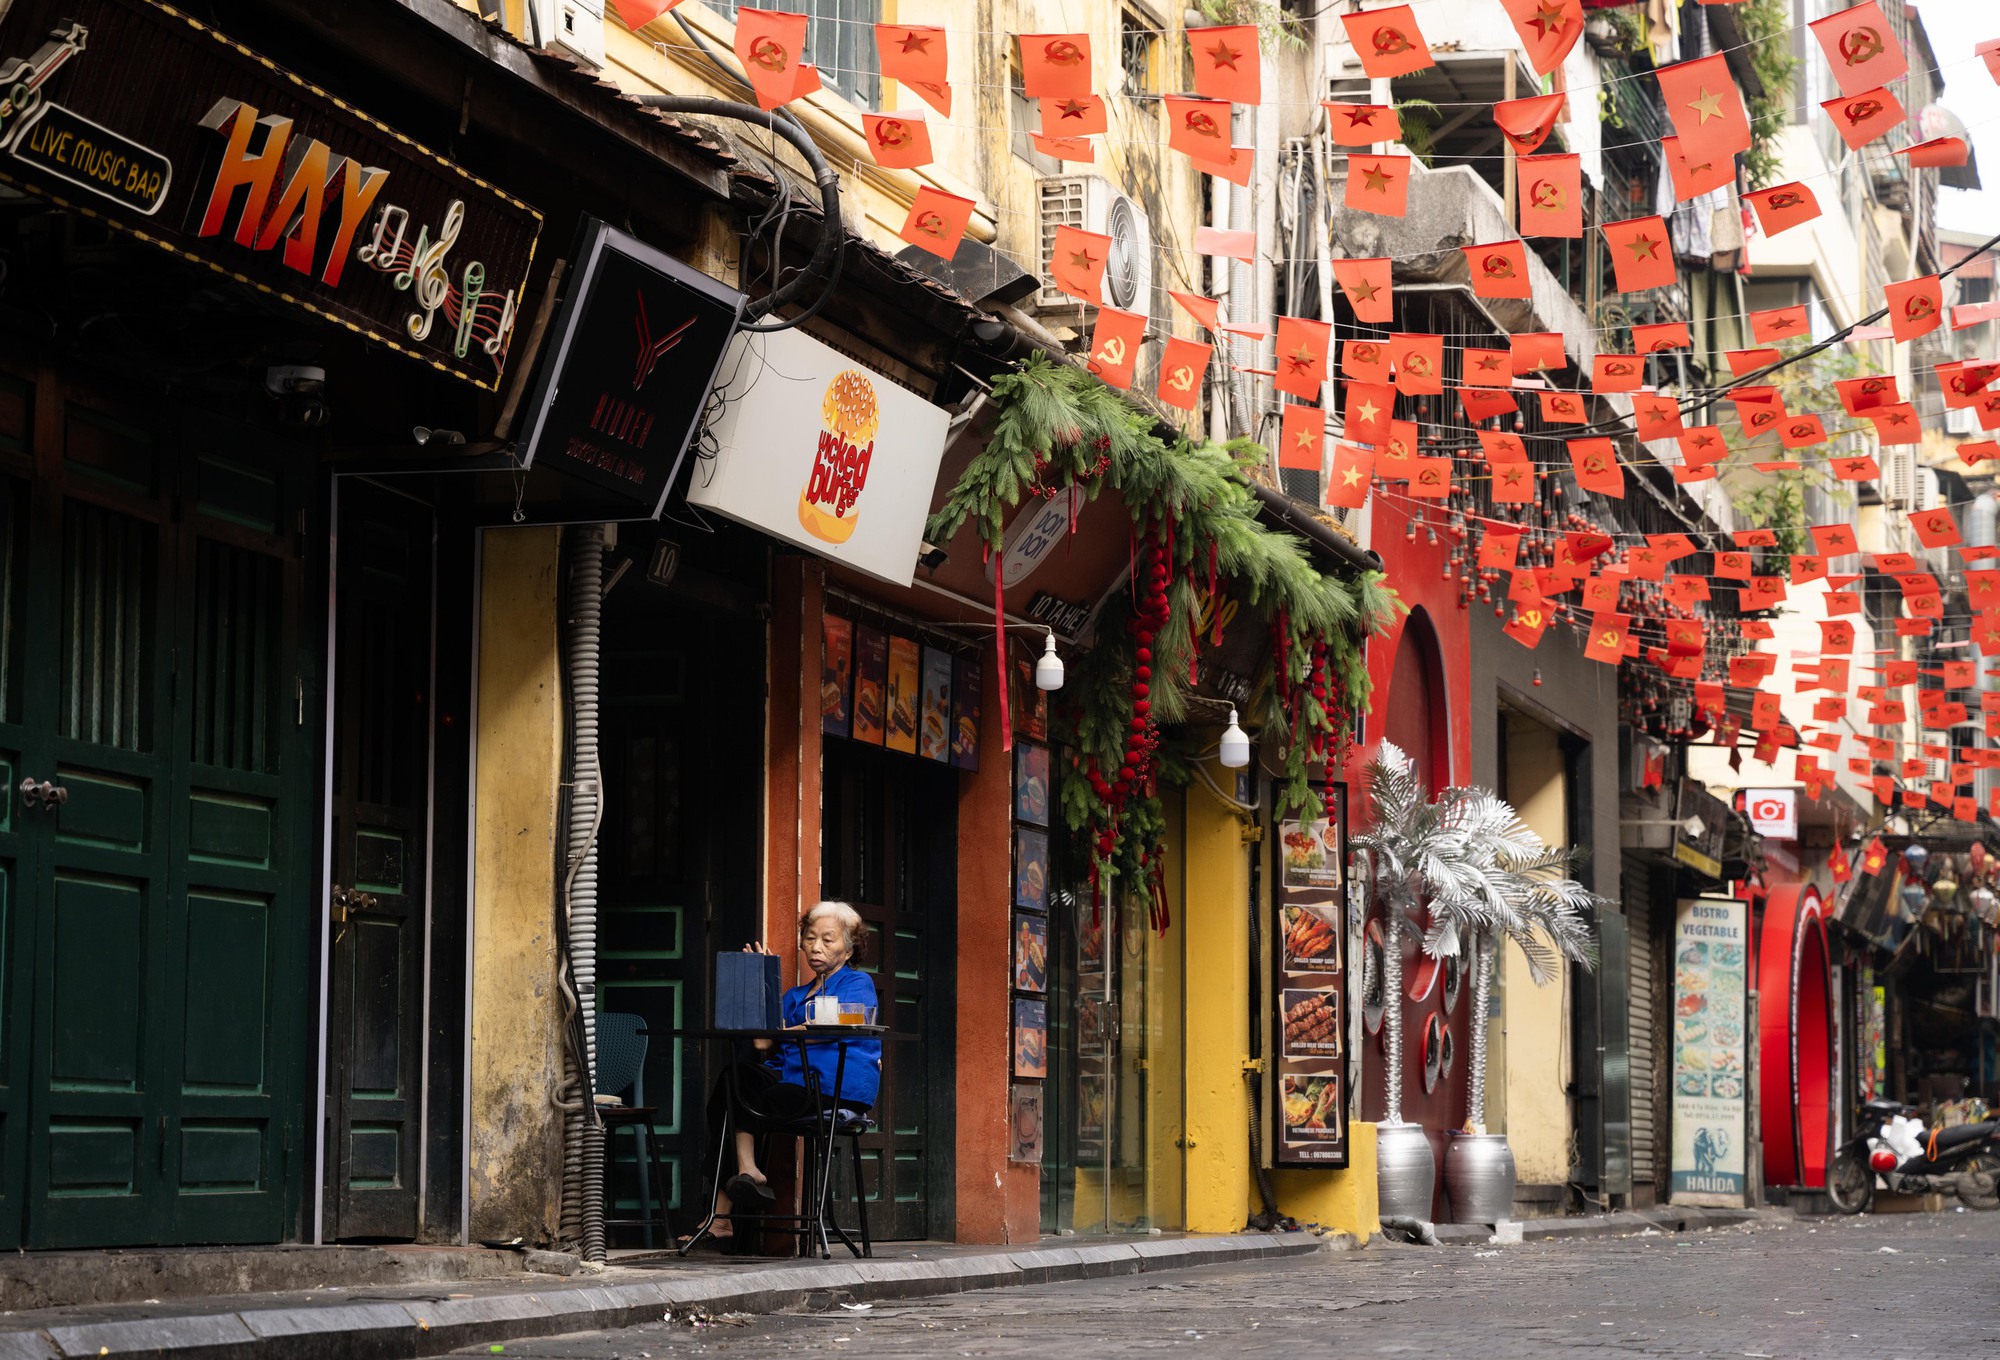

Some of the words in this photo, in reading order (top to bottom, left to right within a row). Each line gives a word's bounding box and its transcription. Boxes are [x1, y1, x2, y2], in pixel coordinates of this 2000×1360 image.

[29, 120, 73, 164] LIVE
[70, 138, 126, 187] MUSIC
[124, 162, 161, 200] BAR
[198, 97, 390, 288] HAY
[818, 430, 874, 491] wicked
[806, 449, 859, 518] burger
[1034, 510, 1067, 537] DON
[1017, 532, 1050, 560] DON
[653, 545, 675, 578] 10
[1030, 595, 1053, 619] 10
[1692, 906, 1729, 920] BISTRO
[1683, 923, 1738, 938] VEGETABLE
[1686, 1175, 1735, 1193] HALIDA
